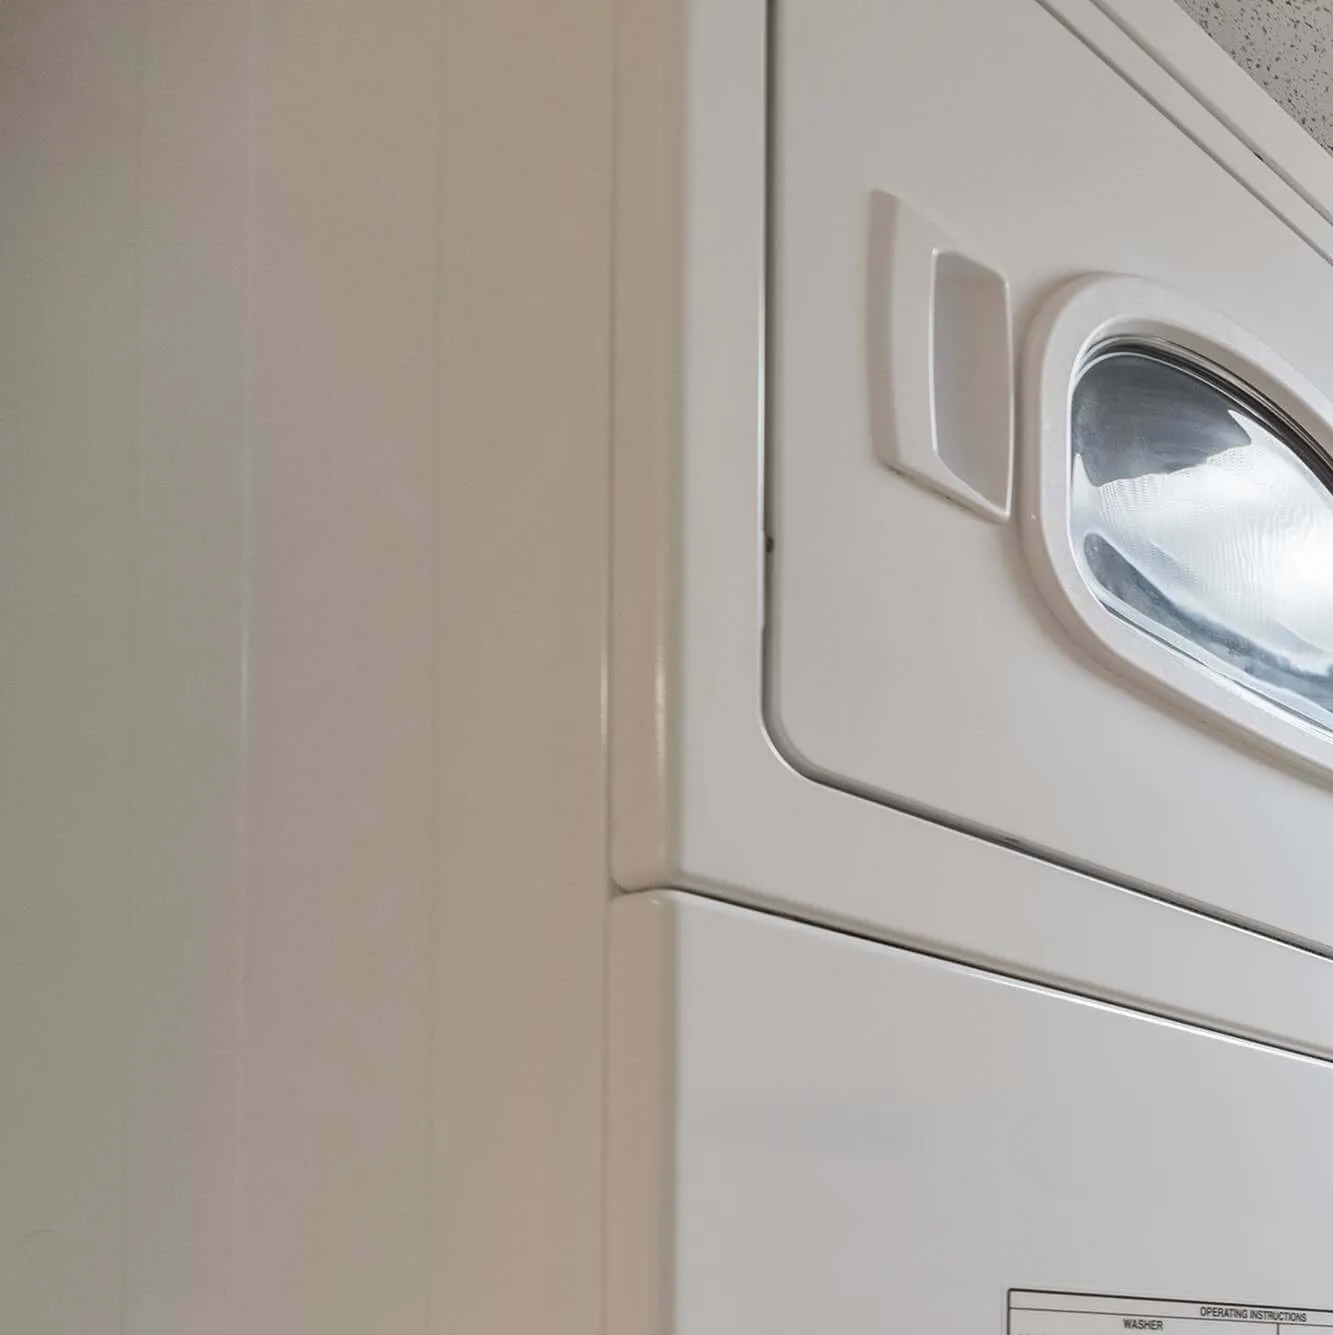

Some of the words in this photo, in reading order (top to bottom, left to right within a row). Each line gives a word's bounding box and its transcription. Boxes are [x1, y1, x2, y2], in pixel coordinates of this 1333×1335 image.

[1200, 1306, 1247, 1319] OPERATING
[1250, 1311, 1307, 1322] INSTRUCTIONS
[1123, 1319, 1163, 1330] WASHER
